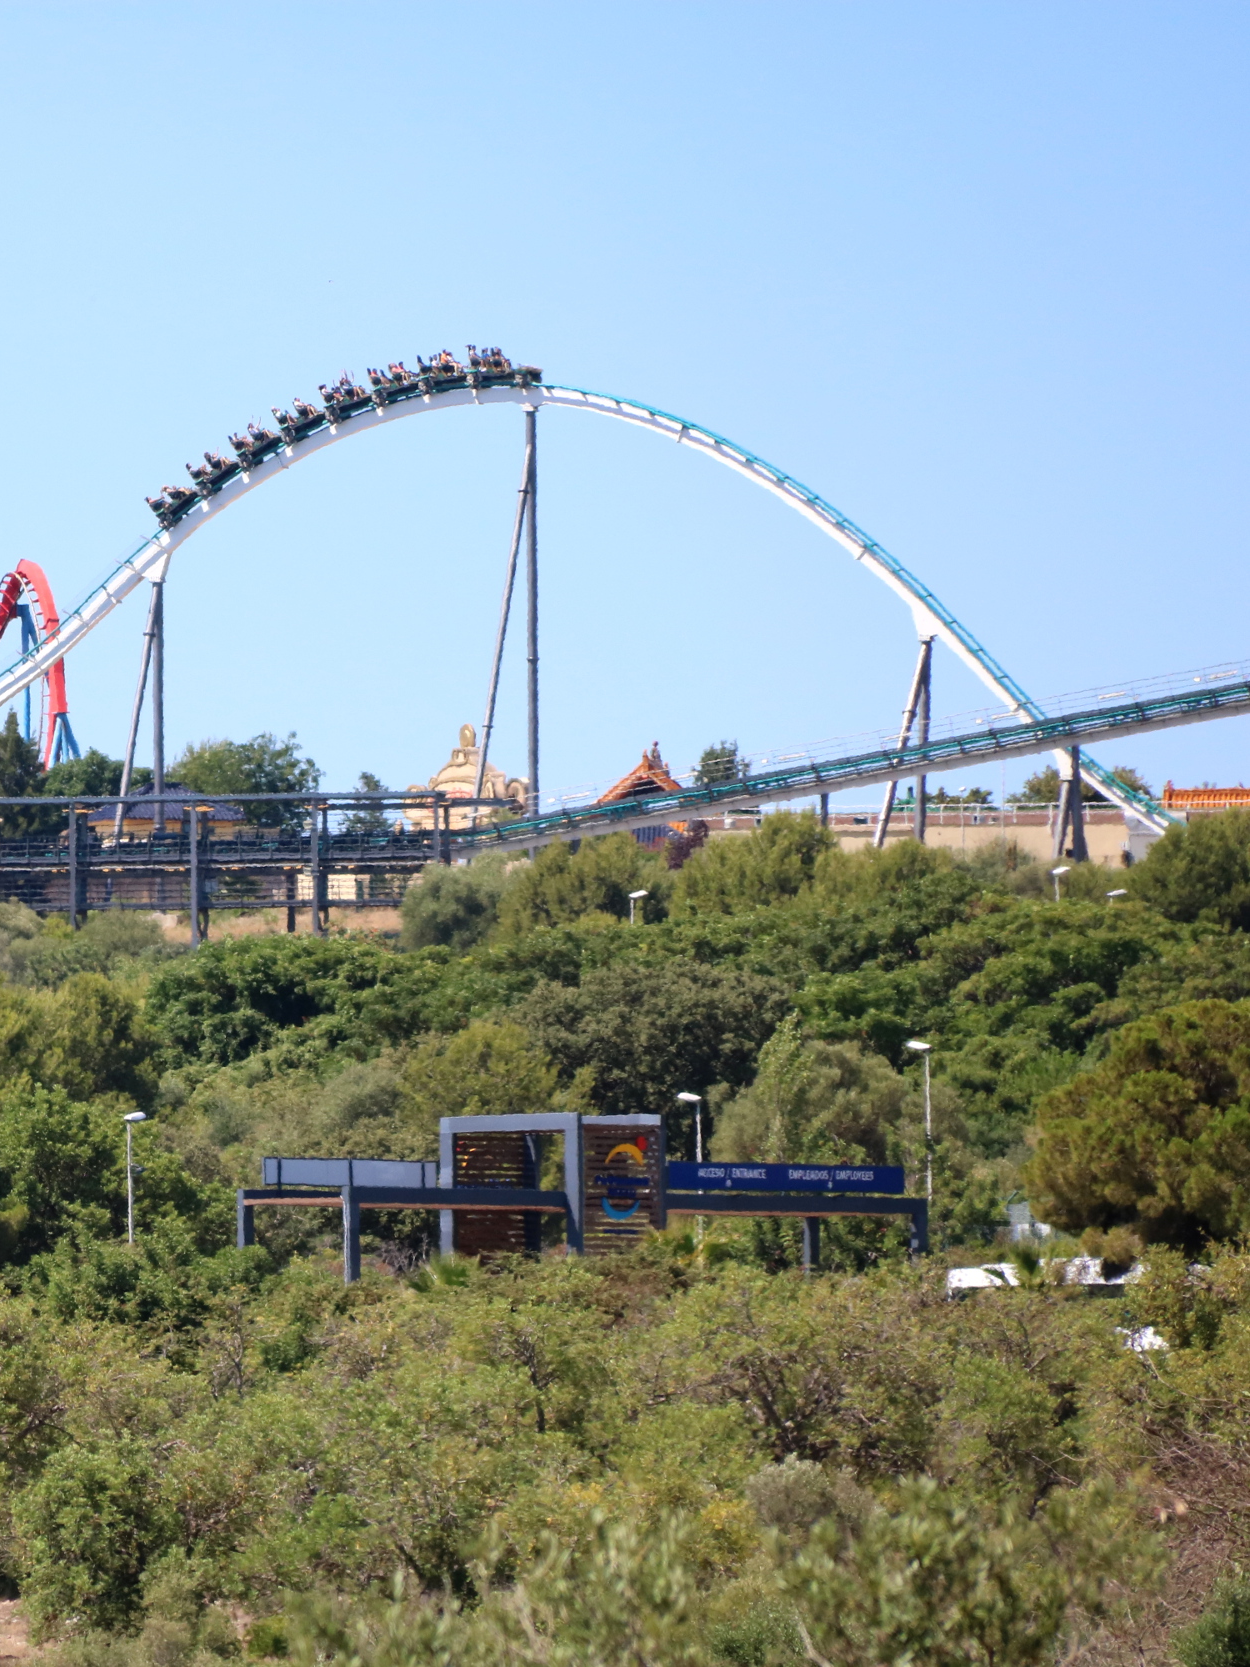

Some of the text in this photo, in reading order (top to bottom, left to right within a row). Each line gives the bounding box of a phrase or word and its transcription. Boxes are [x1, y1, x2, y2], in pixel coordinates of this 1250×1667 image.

[731, 1168, 767, 1179] ENTRANCE
[788, 1169, 829, 1180] EMPLEADOS
[835, 1170, 874, 1181] EMPLOYEES
